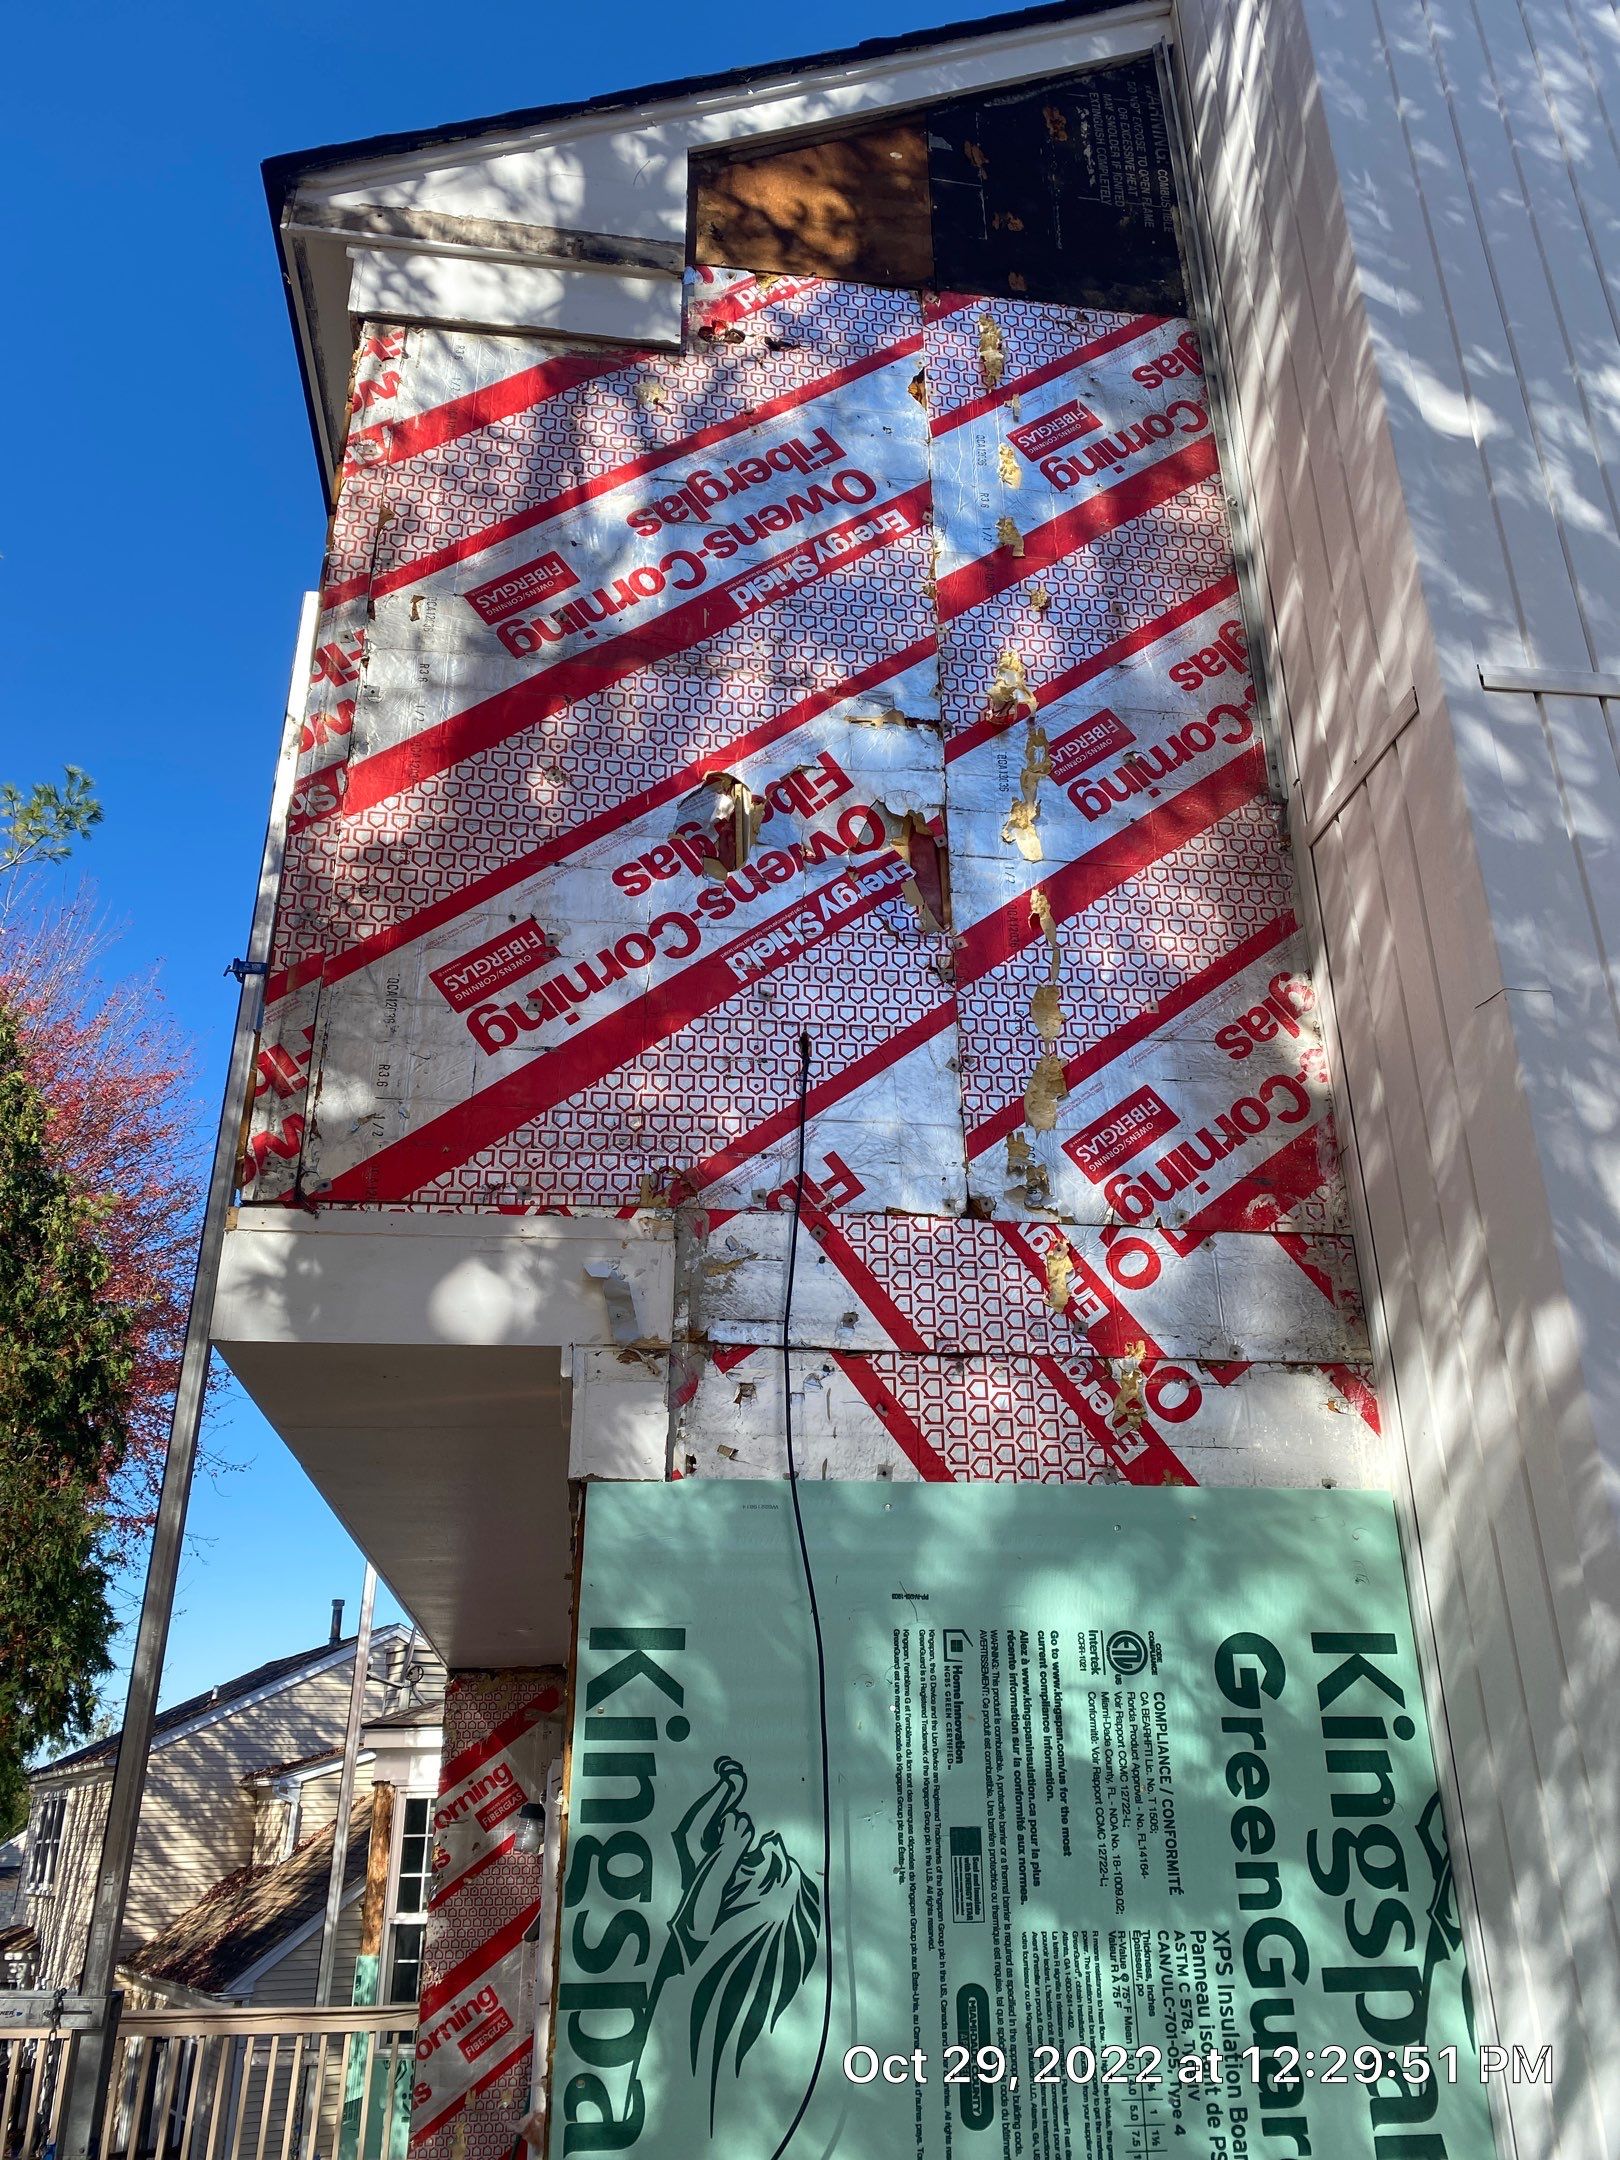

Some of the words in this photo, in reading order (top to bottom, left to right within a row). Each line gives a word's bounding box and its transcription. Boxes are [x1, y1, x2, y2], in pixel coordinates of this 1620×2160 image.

[1089, 92, 1106, 145] EXTINGUISH
[1117, 107, 1129, 120] OR
[1105, 114, 1121, 158] SMOLDER
[1120, 122, 1136, 172] EXCESSIVE
[1096, 147, 1113, 206] COMPLETELY
[1111, 160, 1122, 170] IF
[1137, 155, 1148, 167] TO
[1112, 171, 1126, 208] IGNITED
[1125, 172, 1139, 197] HEAT
[1016, 407, 1089, 448] FIBERGLAS
[1028, 424, 1082, 454] OWENS/CORNING
[627, 427, 847, 537] Fiberglas
[814, 508, 908, 568] Energy
[496, 469, 877, 660] Owens-Corning
[728, 553, 819, 613] Shield
[476, 560, 565, 610] FIBERGLAS
[486, 580, 555, 616] OWENS/CORNING
[1054, 737, 1114, 778] OWENS/CORNING
[818, 857, 917, 923] Energy
[443, 929, 544, 993] FIBERGLAS
[724, 908, 825, 984] Shield
[454, 954, 533, 1002] OWENS/CORNING
[376, 1064, 391, 1088] R3.6
[1075, 1098, 1162, 1164] FIBERGLAS
[1090, 1121, 1154, 1173] OWENS/CORNING
[1006, 1629, 1017, 1671] récente
[1019, 1629, 1029, 1656] Allez
[1037, 1629, 1048, 1669] current
[1050, 1630, 1060, 1647] Go
[1051, 1647, 1060, 1660] to
[1077, 1632, 1087, 1672] CCRR-1021
[1088, 1630, 1100, 1676] Intertek
[1020, 1657, 1031, 1666] à
[952, 1665, 963, 1700] Home
[1113, 1690, 1124, 1710] Voir
[1139, 1691, 1150, 1707] CA
[1008, 1672, 1021, 1735] information
[1038, 1670, 1051, 1734] compliance
[1100, 1691, 1113, 1747] Miami-Dade
[1126, 1691, 1138, 1723] Florida
[953, 1700, 966, 1765] Innovation
[1052, 1661, 1068, 1785] www.kingspan.com/us
[1114, 1710, 1126, 1749] Rapport
[1153, 1691, 1172, 1785] COMPLIANCE
[1011, 1736, 1020, 1756] sur
[1021, 1667, 1037, 1817] www.kingspaninsulation.ca
[1091, 1746, 1101, 1765] Voir
[1129, 1723, 1140, 1761] Product
[1013, 1757, 1023, 1768] la
[1043, 1735, 1056, 1802] information.
[1104, 1748, 1115, 1784] County,
[1117, 1750, 1129, 1783] CCMC
[1013, 1769, 1027, 1832] conformité
[1059, 1786, 1069, 1804] for
[1091, 1766, 1104, 1805] Rapport
[1107, 1786, 1117, 1800] FL
[1130, 1762, 1144, 1804] Approval
[1146, 1777, 1156, 1795] No.
[1147, 1796, 1157, 1805] T
[1060, 1805, 1070, 1825] the
[1095, 1806, 1107, 1841] CCMC
[1108, 1807, 1119, 1832] NOA
[1120, 1785, 1132, 1828] 12722-L;
[1135, 1813, 1145, 1831] No.
[1148, 1807, 1159, 1834] 1506;
[1016, 1833, 1026, 1855] aux
[1027, 1819, 1038, 1847] pour
[1061, 1827, 1072, 1857] most
[1110, 1833, 1120, 1851] No.
[1161, 1798, 1185, 1896] CONFORMITÉ
[1031, 1848, 1041, 1860] la
[1098, 1843, 1109, 1887] 12722-L;
[1137, 1833, 1150, 1880] FL14164-
[1018, 1857, 1028, 1906] normes.
[1029, 1861, 1042, 1887] plus
[1112, 1854, 1125, 1915] 18-1009.02;
[1108, 1930, 1118, 1963] Valeur
[1117, 1930, 1128, 1970] R-Value
[1140, 1929, 1153, 1981] Thickness,
[1173, 1929, 1189, 1977] ASTM
[1211, 1929, 1234, 1976] XPS
[1110, 1964, 1120, 1973] R
[1119, 1972, 1130, 1983] @
[1112, 1985, 1122, 1999] 75
[1121, 1985, 1131, 2004] 75°
[1135, 1983, 1144, 1996] po
[1146, 1984, 1156, 2017] inches
[1154, 1930, 1180, 2074] CAN/ULC-701-05,
[1178, 1982, 1191, 1993] C
[1123, 2005, 1133, 2014] F
[1179, 1998, 1194, 2035] 578,
[1124, 2015, 1133, 2045] Mean
[1189, 1930, 1211, 2018] Panneau
[1206, 2102, 1224, 2129] de
[1217, 1984, 1244, 2099] Insulation
[1166, 2080, 1183, 2119] Type
[1187, 2084, 1200, 2101] IV
[1129, 2105, 1138, 2122] 5.0
[1174, 2123, 1187, 2137] 4
[1131, 2131, 1140, 2148] 7.5
